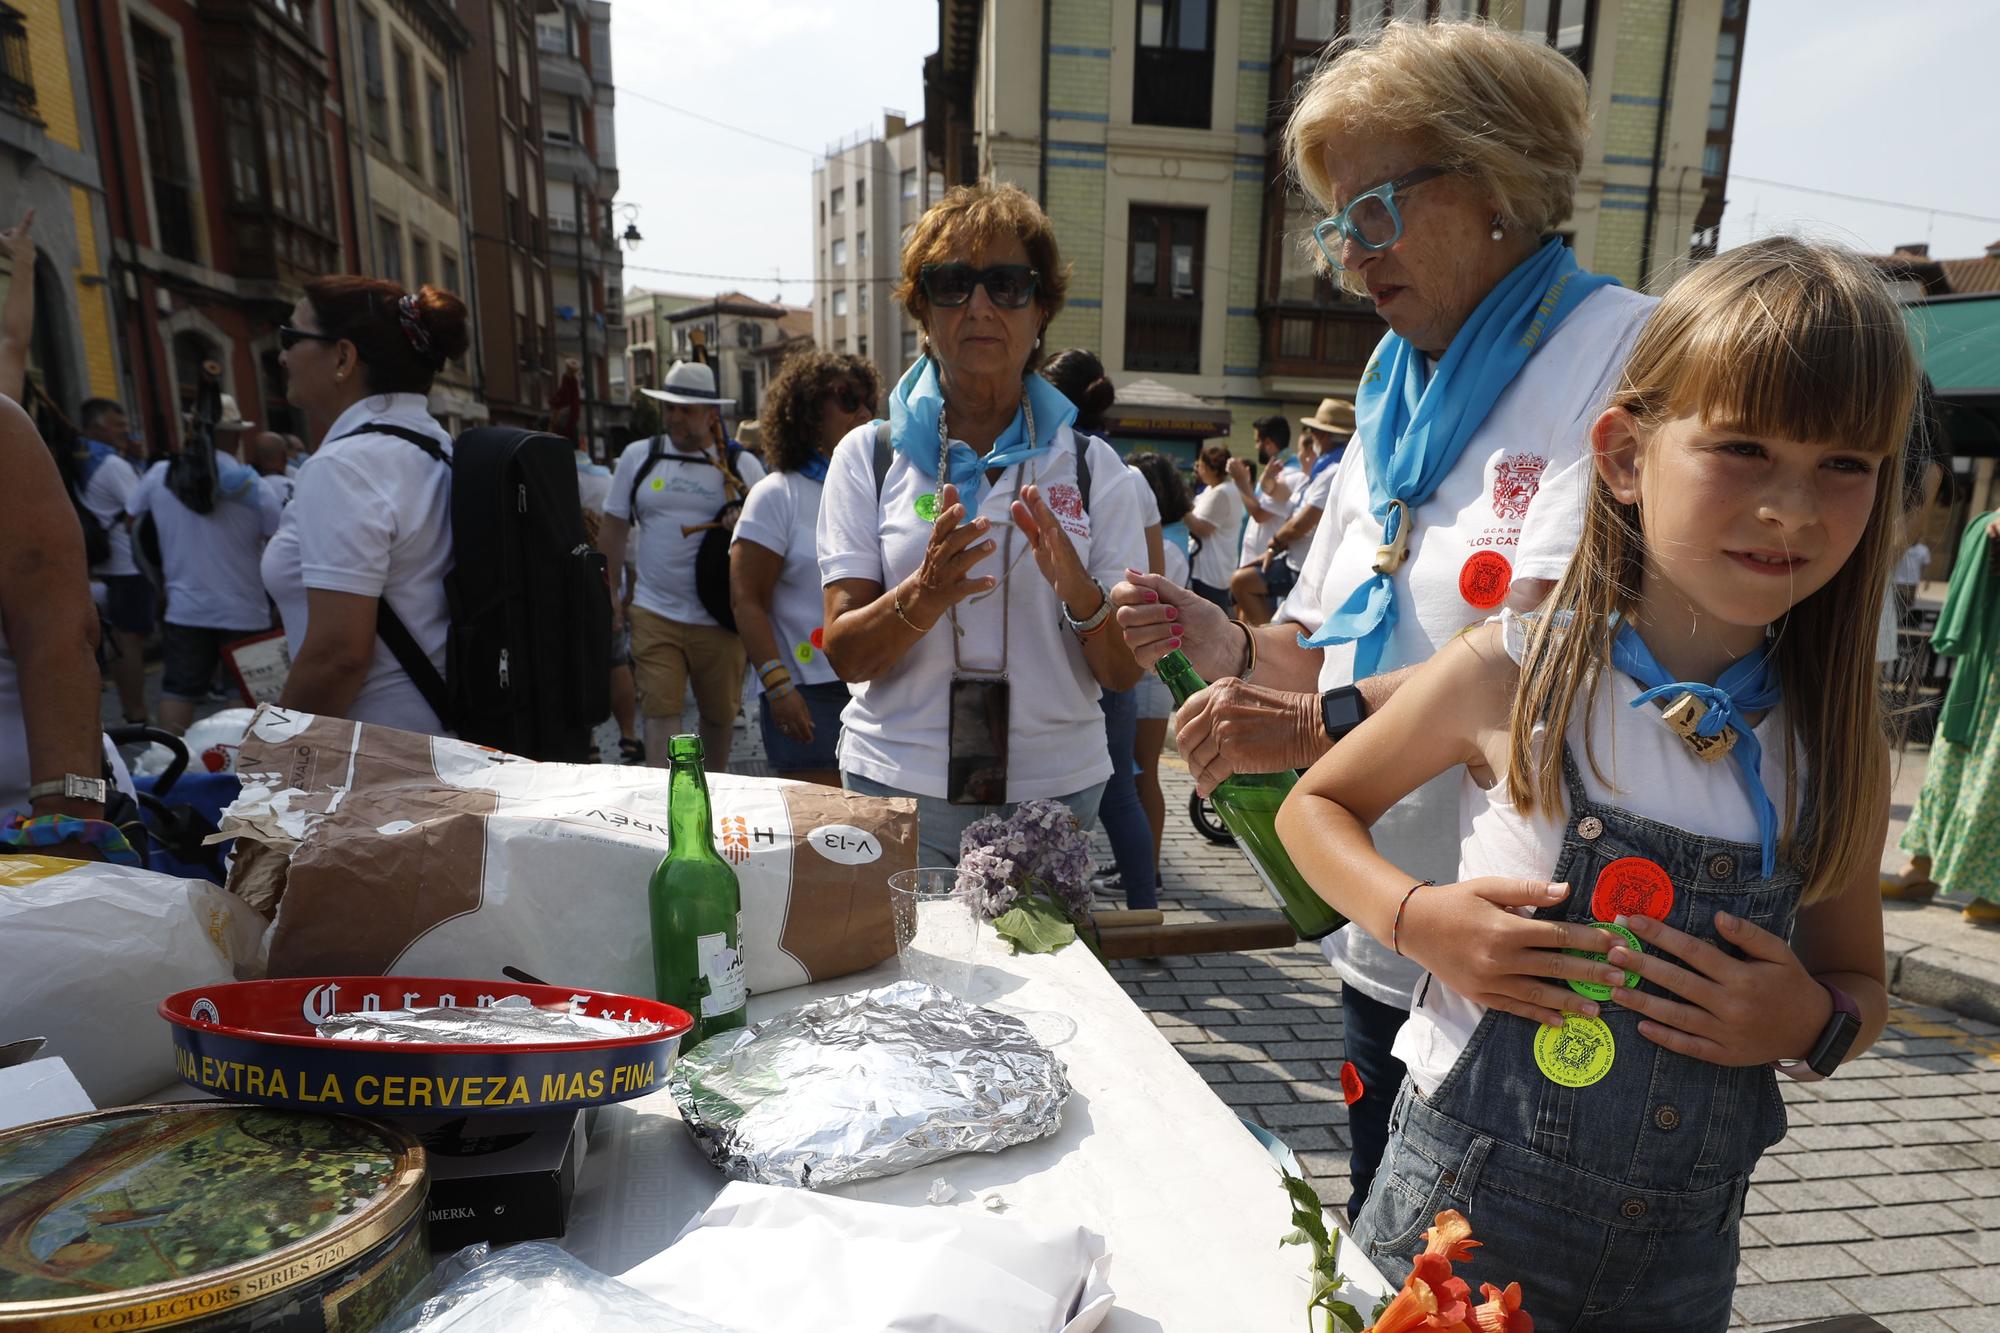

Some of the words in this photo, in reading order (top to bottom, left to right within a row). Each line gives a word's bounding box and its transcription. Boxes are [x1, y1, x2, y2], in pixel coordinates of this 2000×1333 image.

[824, 833, 874, 855] V-13
[202, 1055, 290, 1098] EXTRA
[299, 1071, 345, 1103] LA
[354, 1074, 531, 1107] CERVEZA
[540, 1069, 605, 1103] MAS
[611, 1060, 656, 1095] FINA
[92, 1284, 242, 1331] COLLECTORS
[245, 1257, 311, 1295] SERIES
[315, 1244, 347, 1269] 7/20
